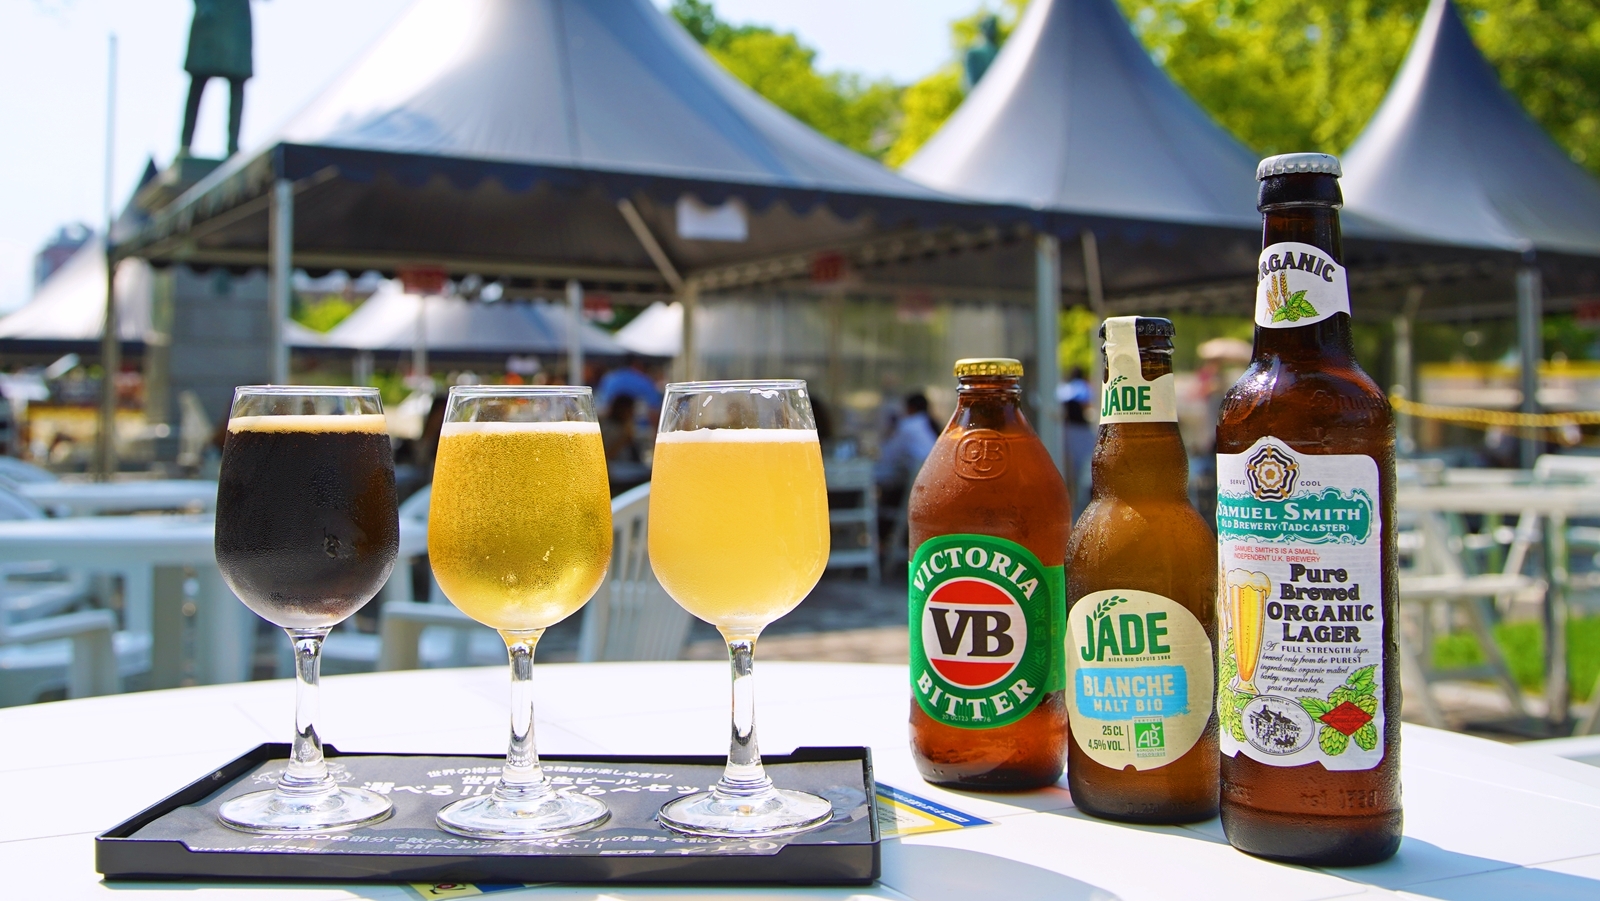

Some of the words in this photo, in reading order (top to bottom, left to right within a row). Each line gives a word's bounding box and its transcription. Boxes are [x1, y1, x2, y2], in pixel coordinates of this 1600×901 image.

[1102, 386, 1151, 417] JADE
[1218, 500, 1277, 520] SAMUEL
[1222, 519, 1232, 528] OLD
[1233, 520, 1278, 531] BREWERY
[913, 547, 1039, 600] VICTORIA
[1289, 563, 1348, 582] Pure
[1280, 583, 1360, 600] Brewed
[1267, 601, 1374, 622] ORGANIC
[929, 608, 1014, 657] VB
[1081, 612, 1170, 662] JADE
[1282, 622, 1361, 643] LAGER
[1263, 641, 1279, 651] A
[1262, 653, 1283, 662] brewed
[1284, 656, 1298, 665] only
[1298, 654, 1316, 666] from
[1317, 656, 1328, 664] the
[1298, 667, 1325, 678] organic
[1326, 666, 1350, 674] malted
[1084, 674, 1175, 698] BLANCHE
[1266, 684, 1282, 693] yeast
[1282, 676, 1308, 686] organic
[917, 670, 1035, 719] BITTER
[1094, 699, 1128, 712] MALT
[1136, 699, 1163, 712] BIO
[1102, 725, 1112, 736] 25
[1113, 725, 1124, 736] CL
[1138, 730, 1160, 747] AB
[1088, 739, 1106, 751] 4,5%
[1107, 740, 1125, 751] VOL.
